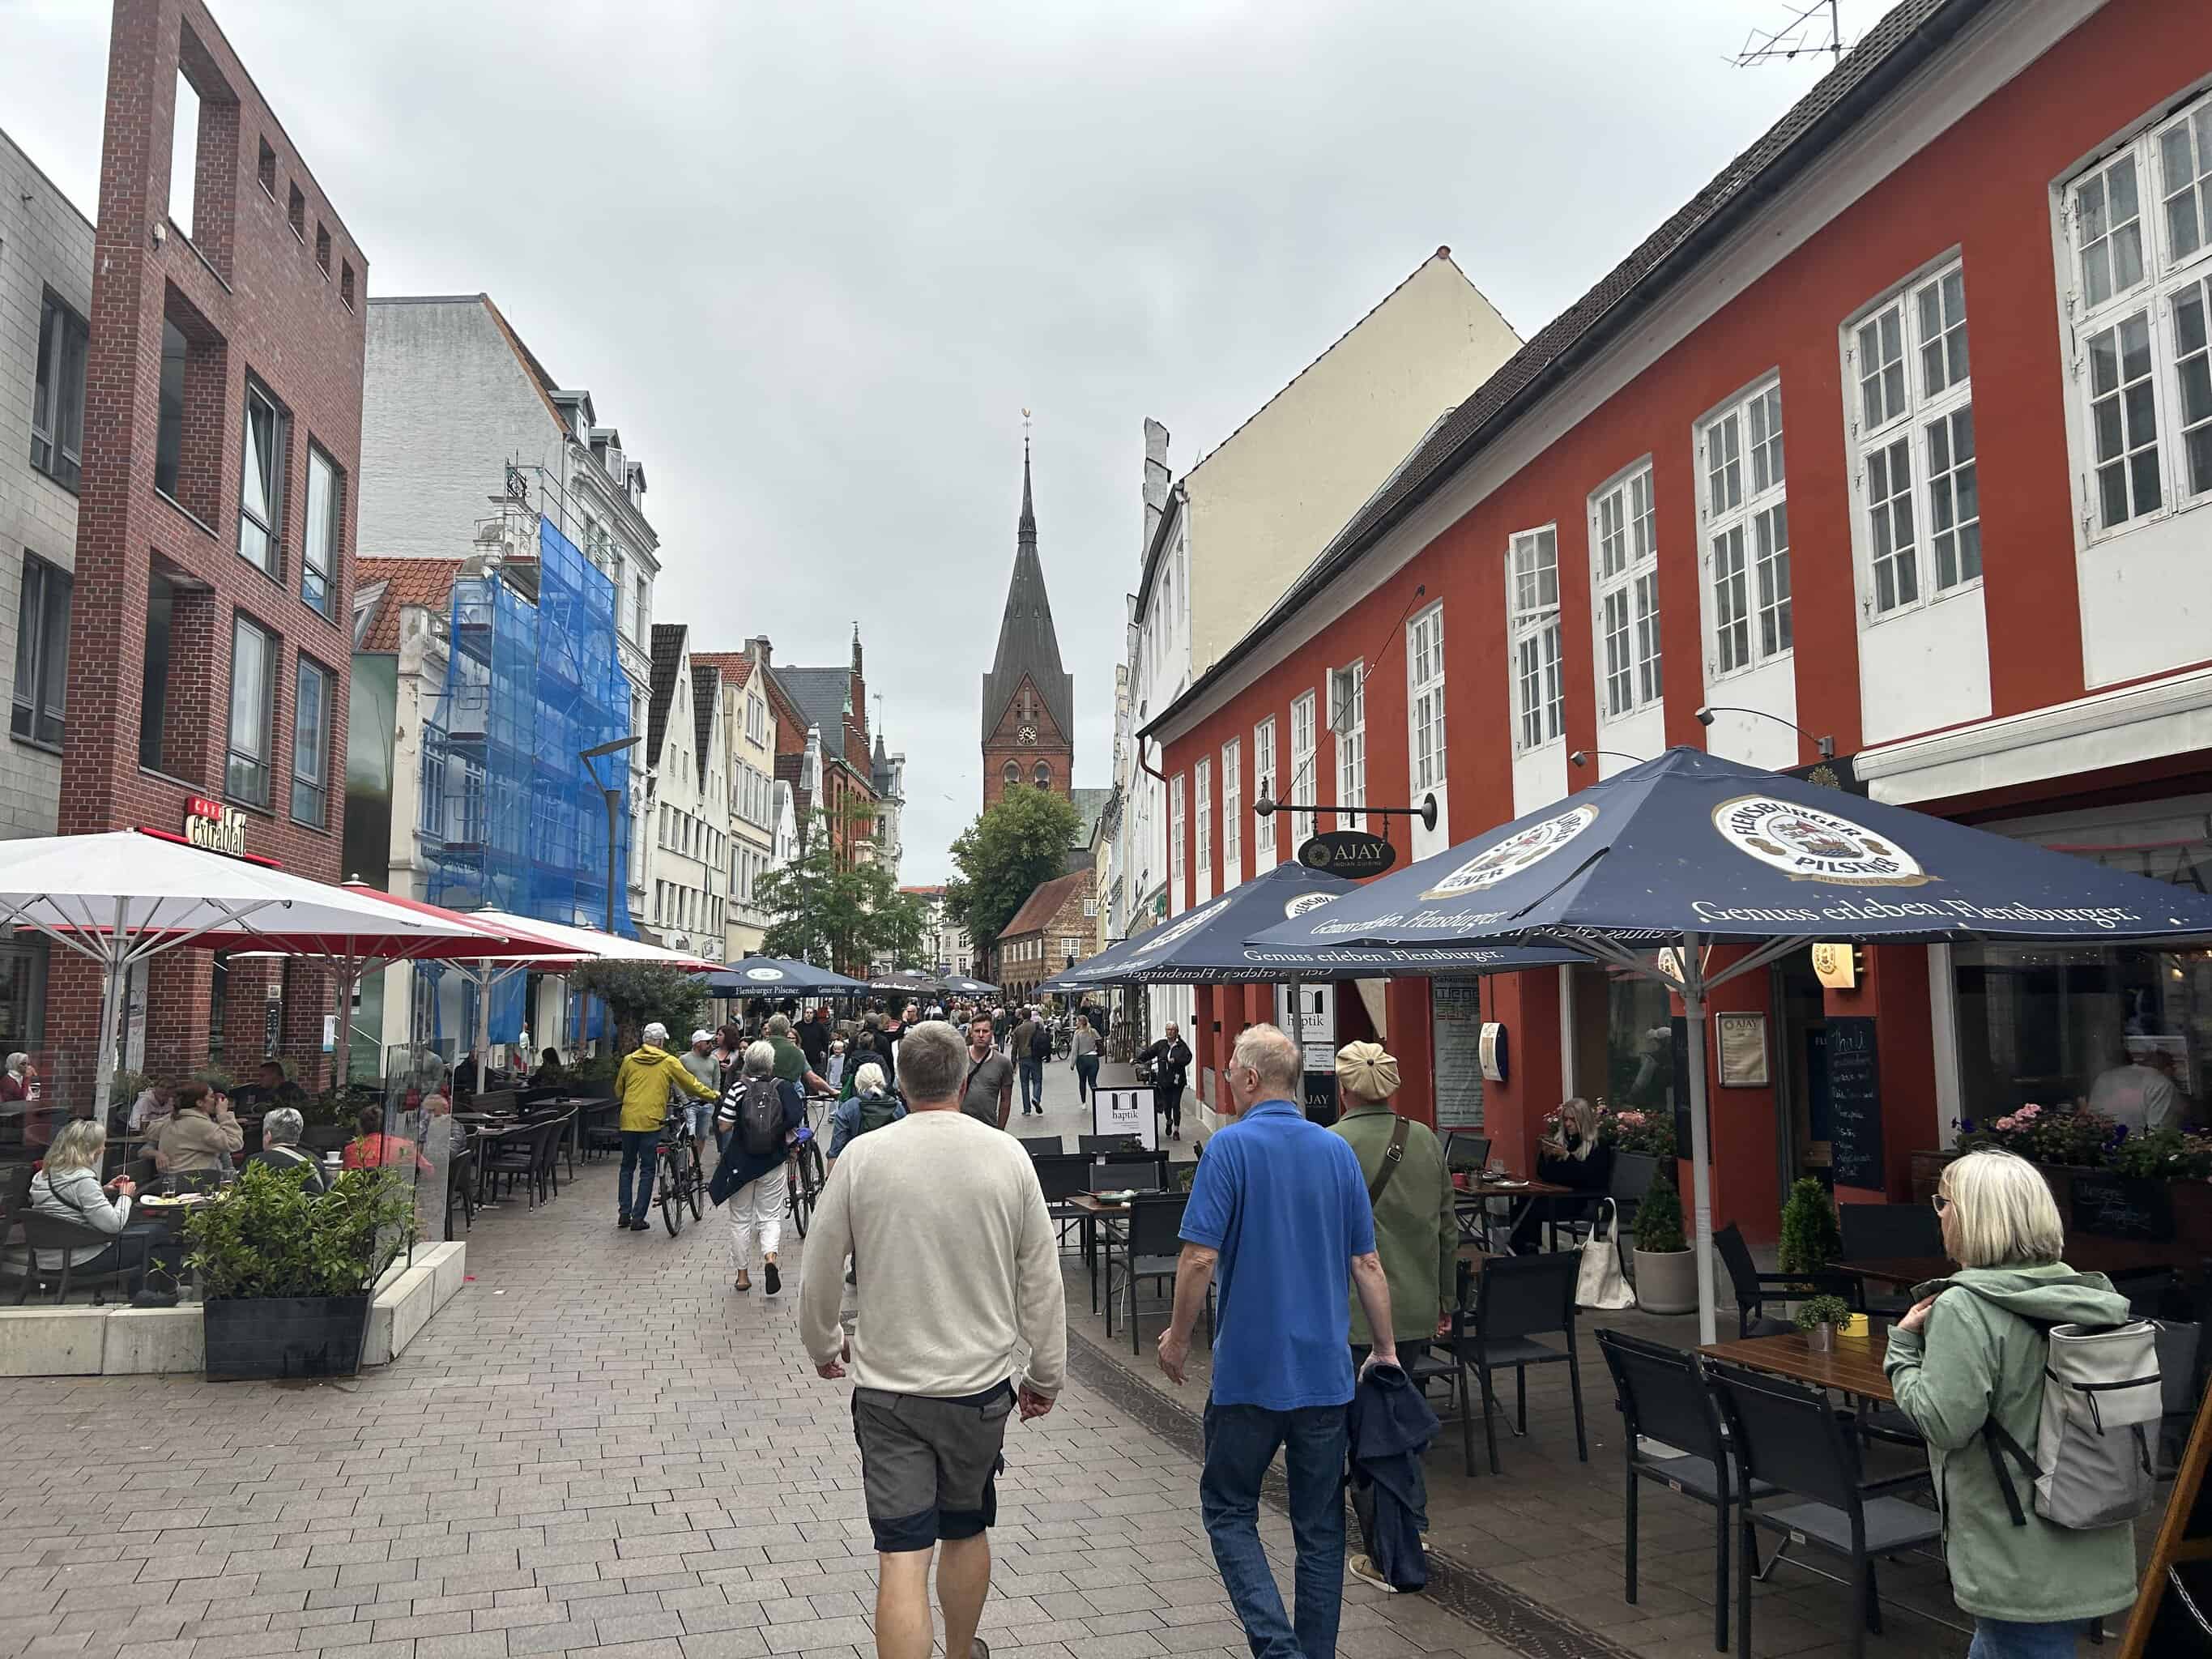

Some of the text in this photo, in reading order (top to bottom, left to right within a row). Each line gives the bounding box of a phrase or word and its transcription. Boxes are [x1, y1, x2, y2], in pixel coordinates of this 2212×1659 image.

[1730, 802, 1863, 837] FLENSBURGER
[193, 807, 247, 855] extrablatt
[1334, 843, 1385, 859] AJAY
[1794, 855, 1900, 875] PILSENER
[1691, 898, 2142, 928] Genuss erleben. Flensburger.
[1243, 949, 1504, 962] Genuss erleben. Flensburger.
[735, 986, 773, 996] Flensburger
[1287, 1014, 1324, 1030] hptik
[1736, 1020, 1756, 1028] AJAY
[1306, 1094, 1329, 1105] JAY
[1112, 1110, 1139, 1121] haptik
